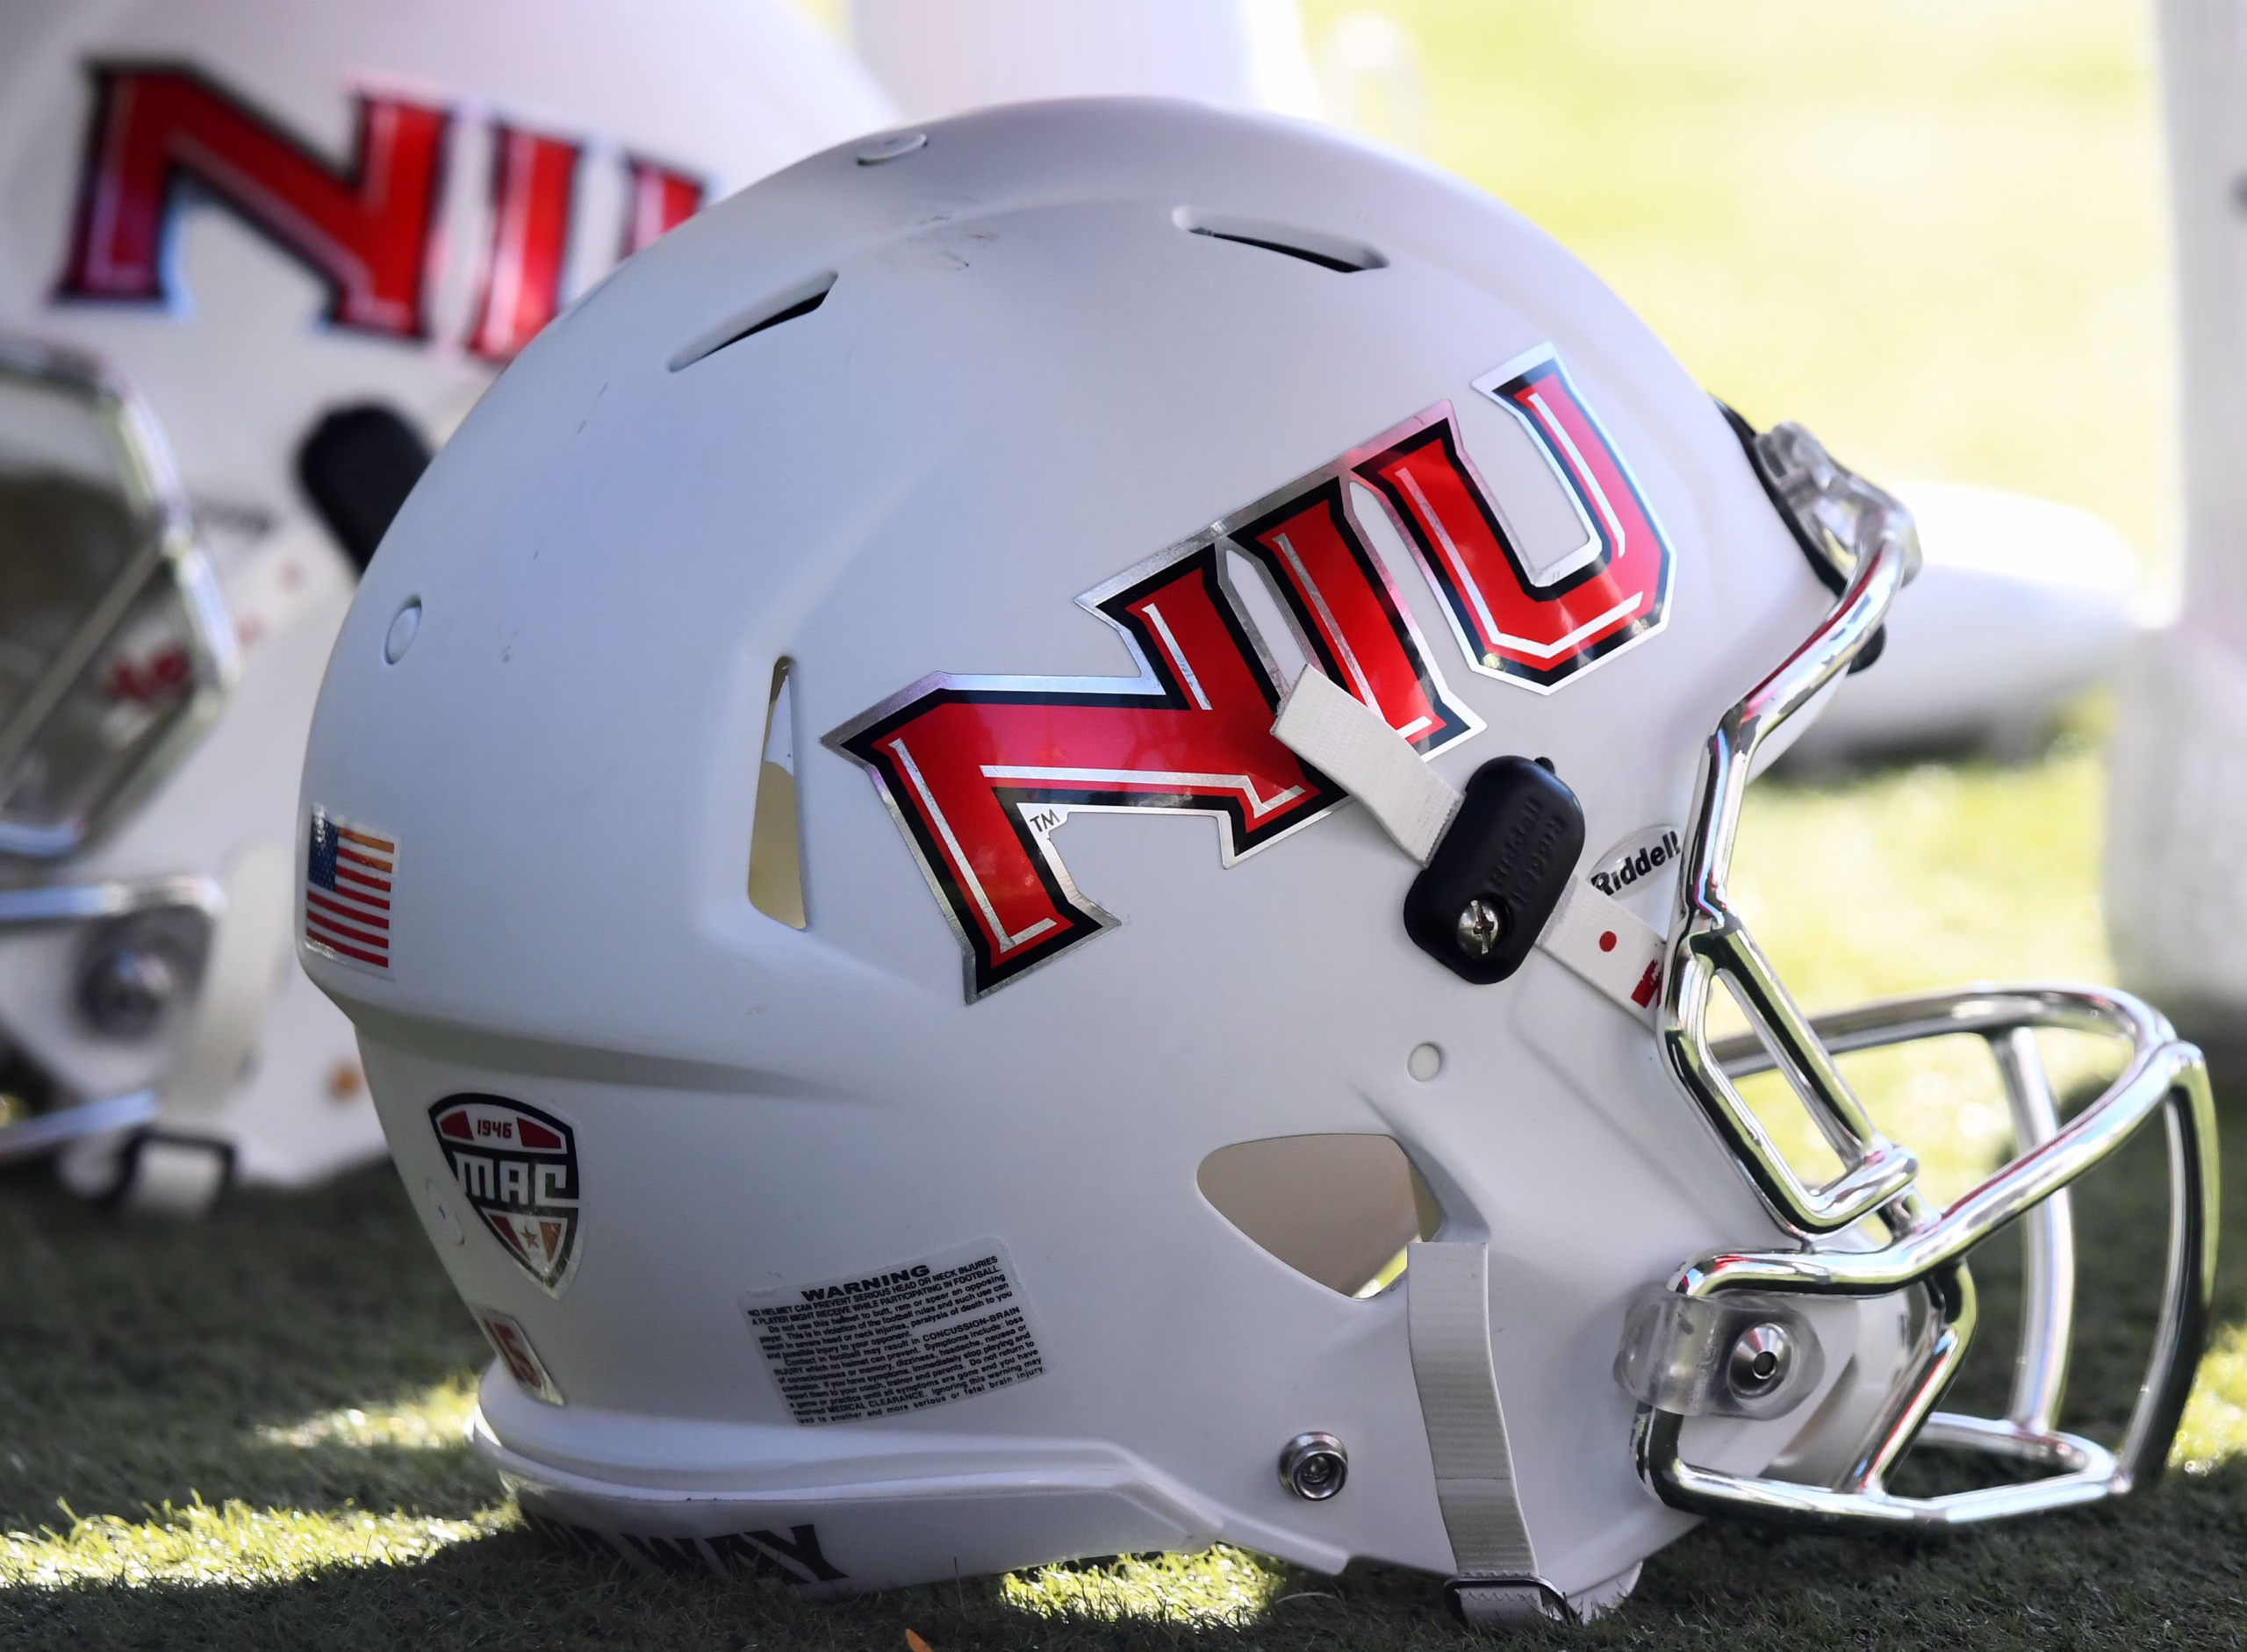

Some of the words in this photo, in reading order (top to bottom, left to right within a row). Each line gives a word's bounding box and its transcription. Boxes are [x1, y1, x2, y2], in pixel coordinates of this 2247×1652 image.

[820, 341, 1676, 1005] NIU
[1029, 808, 1060, 833] TM
[1590, 830, 1681, 896] Riddell
[477, 1119, 513, 1138] 1946
[451, 1151, 579, 1207] MAC
[758, 1315, 789, 1324] PLAYER
[815, 1305, 851, 1317] RECEIVE
[852, 1300, 879, 1311] WHILE
[880, 1283, 943, 1304] PARTICIPATING
[954, 1265, 1001, 1285] FOOTBALL.
[761, 1306, 793, 1315] HELMET
[814, 1296, 852, 1309] PREVENT
[853, 1288, 891, 1302] SERIOUS
[893, 1281, 917, 1292] HEAD
[918, 1276, 931, 1286] OR
[933, 1269, 958, 1282] NECK
[958, 1255, 999, 1274] INJURIES
[801, 1264, 930, 1301] WARNING
[872, 1306, 893, 1316] butt,
[925, 1292, 950, 1304] spear
[965, 1274, 1007, 1291] opposing
[822, 1324, 857, 1334] violation
[882, 1311, 913, 1323] football
[915, 1305, 936, 1315] rules
[937, 1299, 953, 1309] and
[955, 1292, 975, 1304] such
[977, 1288, 993, 1297] use
[994, 1282, 1009, 1291] can
[822, 1334, 842, 1343] head
[854, 1329, 873, 1338] neck
[875, 1323, 909, 1334] injuries,
[910, 1311, 949, 1327] paralysis
[960, 1299, 985, 1311] death
[996, 1290, 1013, 1302] you
[785, 1356, 816, 1365] Contact
[829, 1349, 861, 1360] football
[884, 1340, 909, 1350] result
[922, 1305, 1020, 1341] CONCUSSION-BRAIN
[851, 1340, 869, 1349] your
[871, 1330, 913, 1345] opponent.
[887, 1347, 921, 1361] prevent.
[924, 1333, 969, 1351] Symptoms
[970, 1323, 1004, 1337] include:
[1005, 1316, 1024, 1326] loss
[963, 1348, 983, 1358] stop
[983, 1338, 1015, 1354] playing
[1015, 1331, 1031, 1341] and
[985, 1328, 1016, 1342] nausea
[828, 1401, 867, 1412] MEDICAL
[868, 1390, 928, 1406] CLEARANCE.
[931, 1381, 968, 1395] Ignoring
[969, 1375, 986, 1384] this
[987, 1364, 1023, 1379] warning
[1024, 1357, 1043, 1367] may
[840, 1386, 858, 1395] your
[887, 1375, 914, 1385] trainer
[915, 1370, 930, 1380] and
[932, 1363, 966, 1377] parents.
[984, 1352, 998, 1361] not
[999, 1344, 1025, 1357] return
[896, 1379, 939, 1394] symptoms
[958, 1368, 979, 1380] gone
[980, 1361, 997, 1371] and
[999, 1356, 1016, 1368] you
[1017, 1348, 1038, 1360] have
[866, 1407, 883, 1416] and
[887, 1404, 909, 1412] more
[913, 1395, 947, 1407] serious
[964, 1383, 986, 1395] fatal
[988, 1376, 1013, 1388] brain
